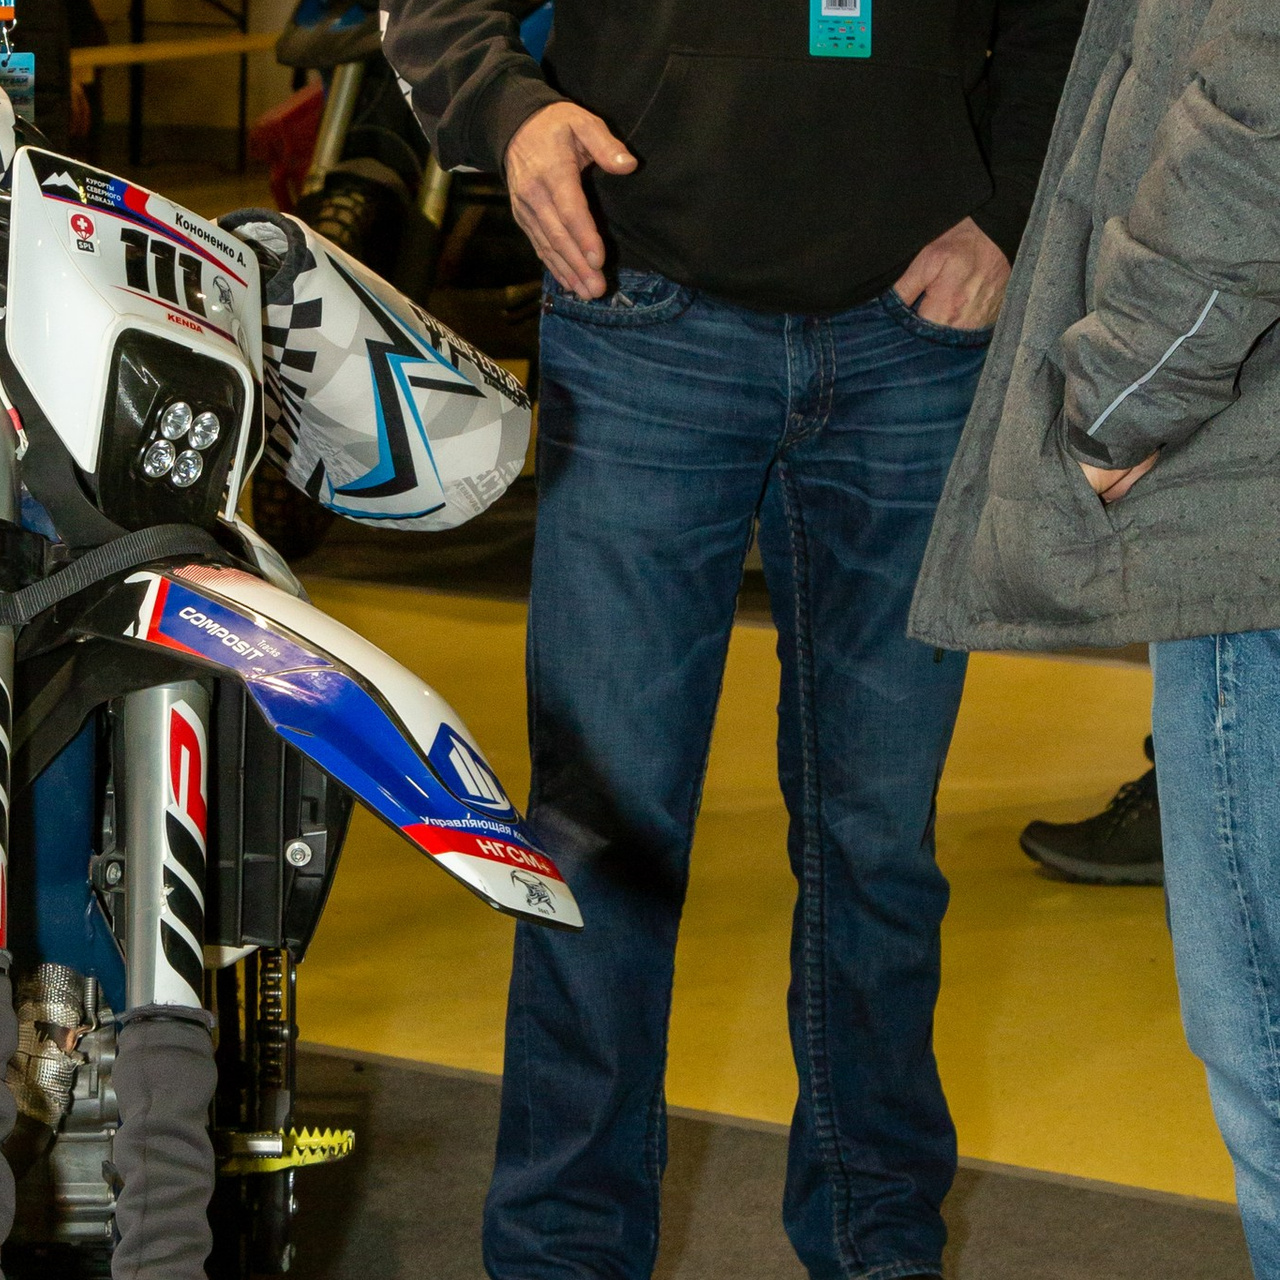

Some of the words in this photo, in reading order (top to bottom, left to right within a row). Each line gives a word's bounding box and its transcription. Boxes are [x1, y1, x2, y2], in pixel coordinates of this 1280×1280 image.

[86, 177, 115, 191] КУРОРТЫ
[86, 185, 122, 201] СЕВЕРНОГО
[87, 193, 115, 207] КАВКАЗА
[78, 241, 94, 252] SPL
[176, 212, 234, 258] Кононенко
[237, 252, 247, 267] А.
[120, 227, 208, 318] 111
[167, 313, 203, 334] KENDA
[179, 606, 264, 662] COMPOSIT
[257, 639, 280, 658] Tracks
[420, 815, 512, 836] Управляющая
